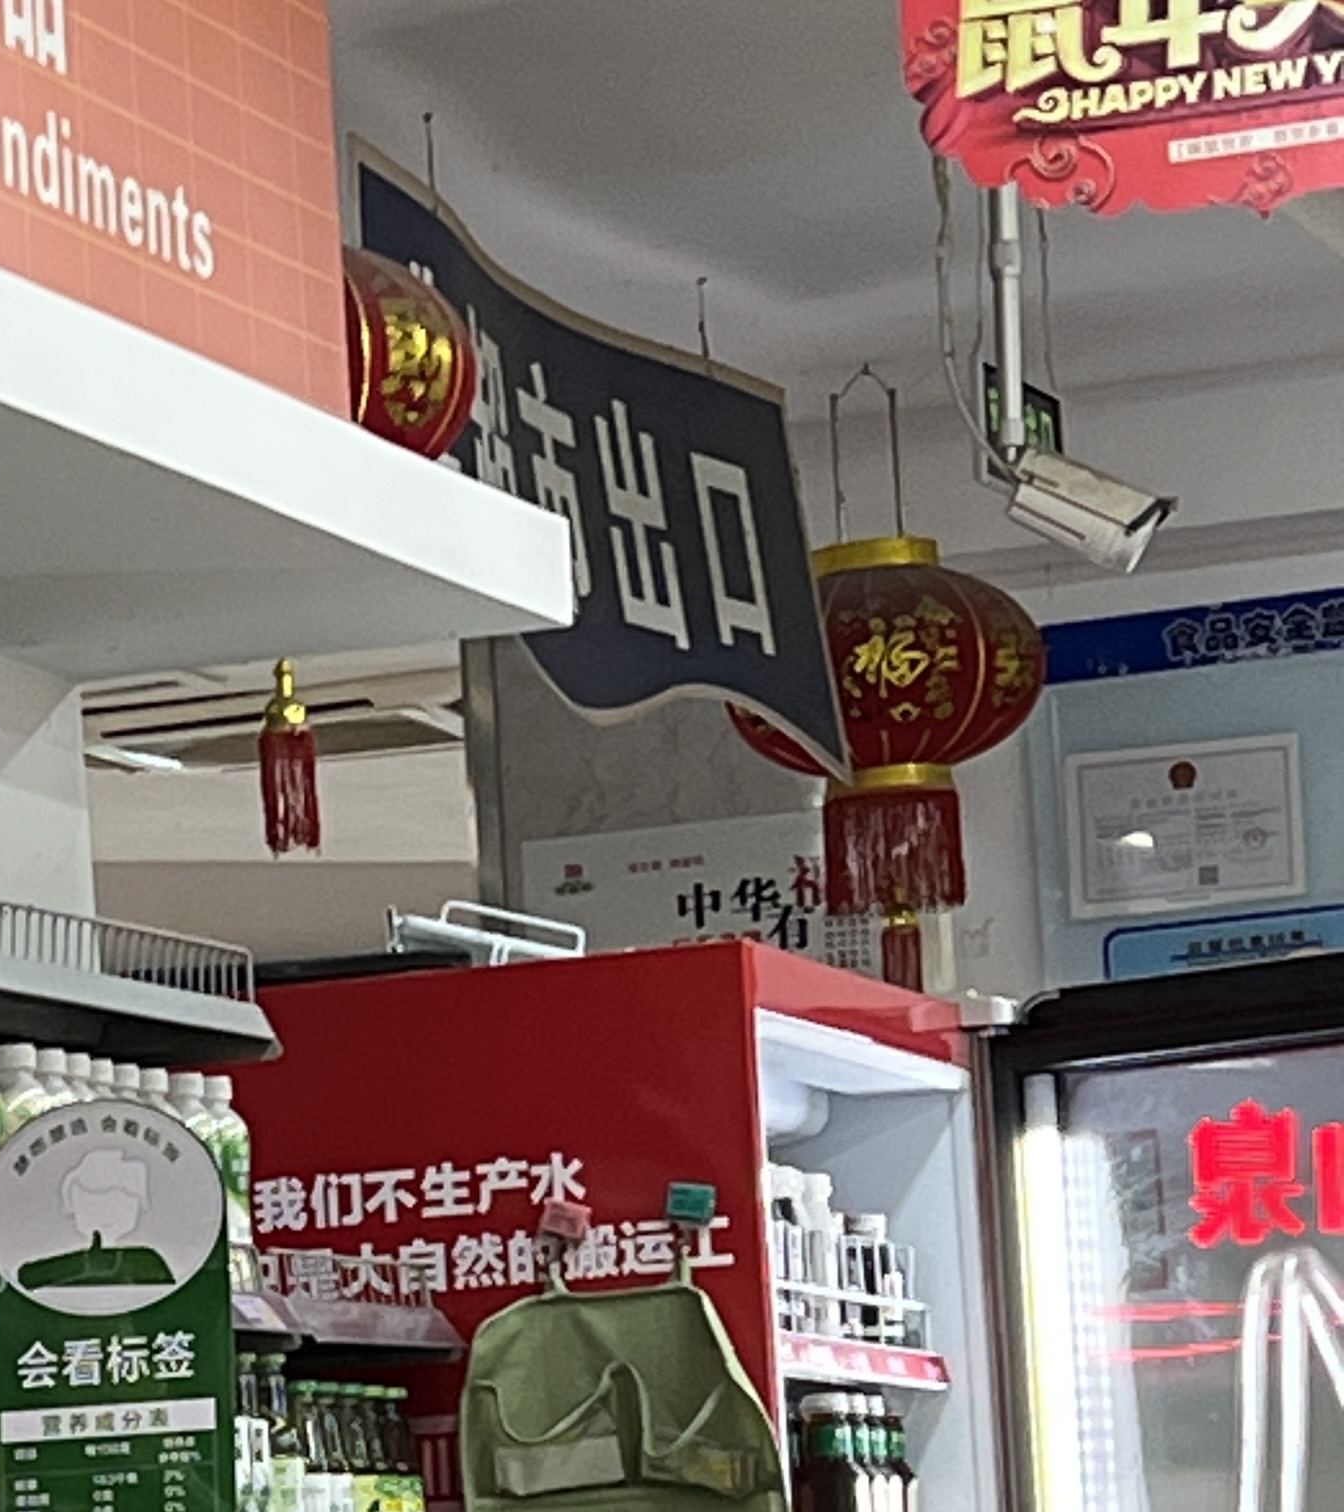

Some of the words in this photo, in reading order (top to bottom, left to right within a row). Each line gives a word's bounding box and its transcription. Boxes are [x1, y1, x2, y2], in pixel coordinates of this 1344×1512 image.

[1070, 70, 1209, 119] HAPPY
[1213, 56, 1308, 100] NEW
[676, 877, 783, 931] 中华
[253, 1151, 587, 1233] 我们不生产水
[16, 1330, 196, 1390] 会看标签
